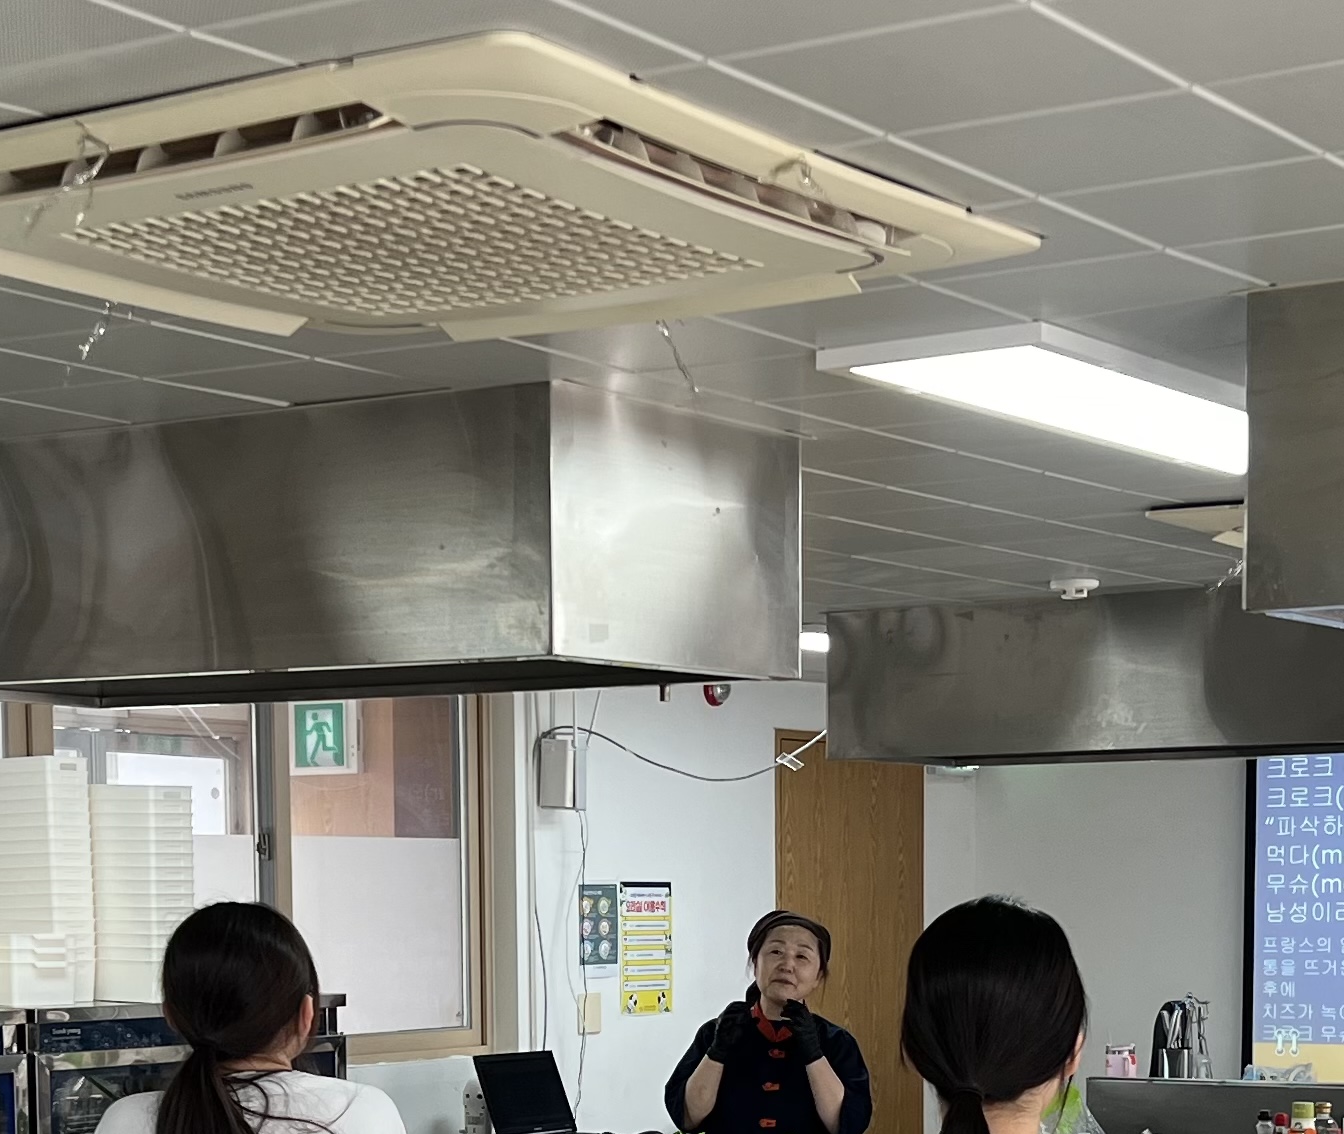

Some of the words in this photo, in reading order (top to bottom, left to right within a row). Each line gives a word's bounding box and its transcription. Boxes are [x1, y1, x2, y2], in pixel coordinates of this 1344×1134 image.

[1266, 755, 1333, 778] 크로크
[1262, 936, 1332, 954] 프랑스의
[1262, 958, 1296, 977] 통을
[1263, 980, 1296, 998] 후에
[1262, 1003, 1313, 1020] 치즈가
